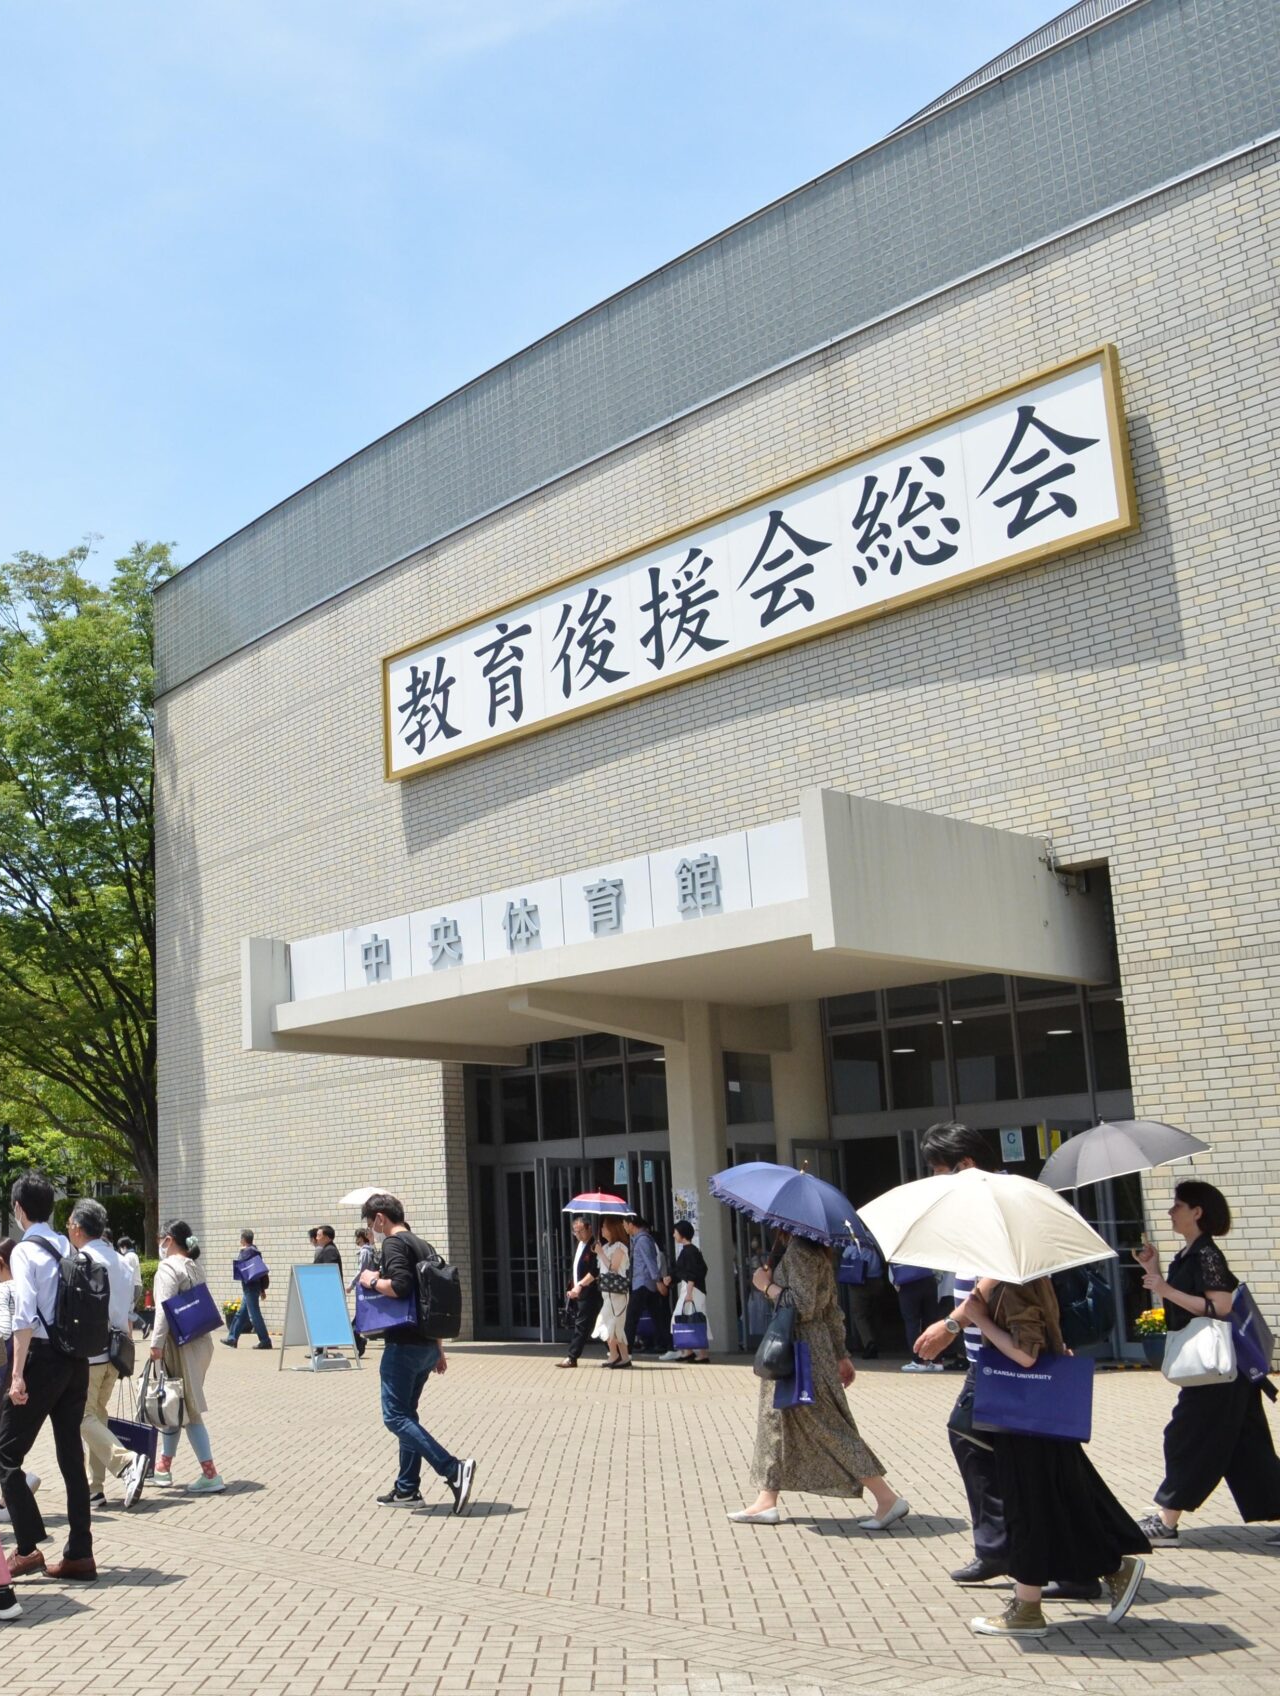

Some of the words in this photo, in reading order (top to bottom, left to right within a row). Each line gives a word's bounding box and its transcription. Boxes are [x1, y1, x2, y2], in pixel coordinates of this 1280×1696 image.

[397, 405, 1101, 755] 教育後援会総会
[360, 851, 721, 982] 中央体育館
[1007, 1132, 1016, 1144] C
[618, 1161, 625, 1170] A
[993, 1369, 1016, 1377] KANSAI
[1017, 1373, 1052, 1381] UNIVERSITY
